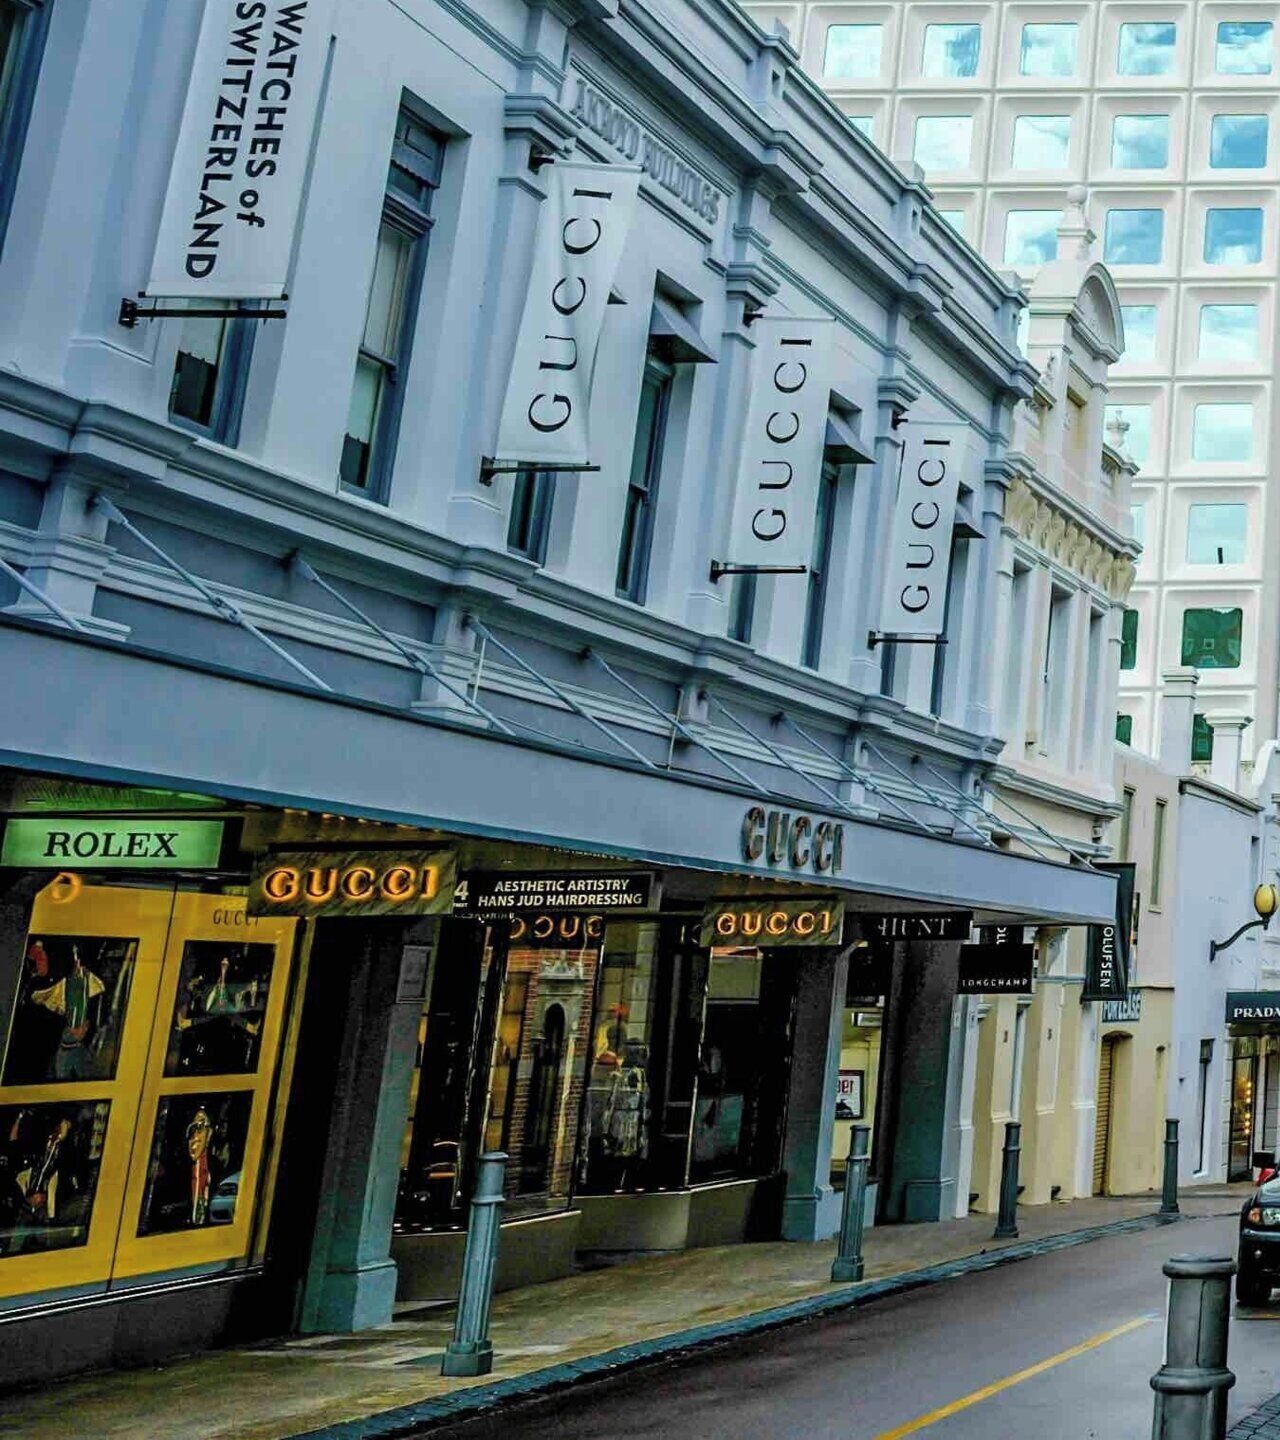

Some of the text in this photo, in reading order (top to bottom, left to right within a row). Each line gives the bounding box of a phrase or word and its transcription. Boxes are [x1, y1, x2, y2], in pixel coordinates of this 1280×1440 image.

[185, 1, 266, 279] SWITZERLAND
[236, 1, 308, 228] WATCHES of
[528, 188, 613, 434] GUCCI
[751, 336, 813, 542] GUCCI
[900, 438, 951, 614] GUCCI
[43, 831, 180, 858] ROLEX
[741, 806, 845, 874] GUCCI
[264, 865, 440, 903] GUCCI
[478, 892, 643, 908] HANS JUD HAIRDRESSING
[494, 878, 630, 893] AESTHETIC ARTISTRY
[716, 911, 834, 937] GUCCI
[1099, 926, 1114, 989] OLUFSEN
